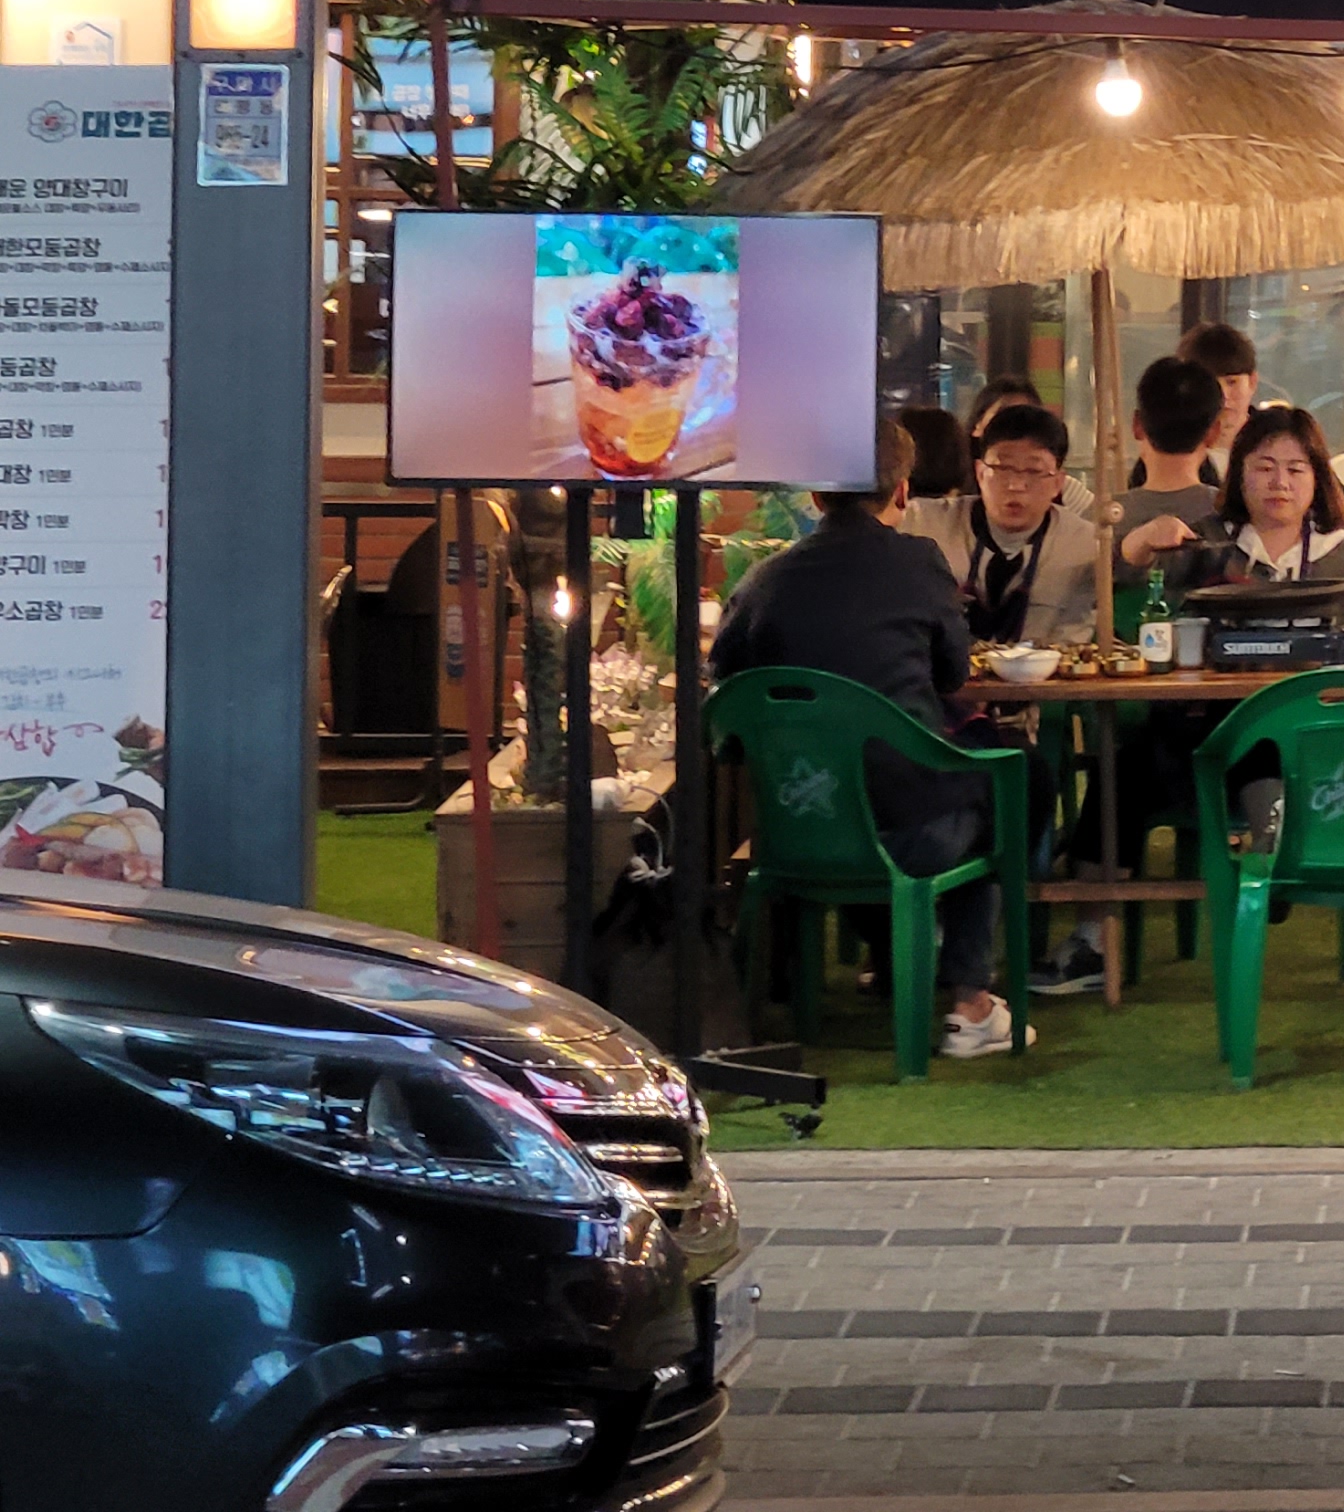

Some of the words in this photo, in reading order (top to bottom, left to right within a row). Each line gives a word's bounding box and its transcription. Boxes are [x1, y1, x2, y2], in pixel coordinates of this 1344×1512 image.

[0, 237, 102, 258] 한모둠곱창
[0, 296, 100, 318] 돌모둠곱창
[0, 600, 64, 621] 소곱창
